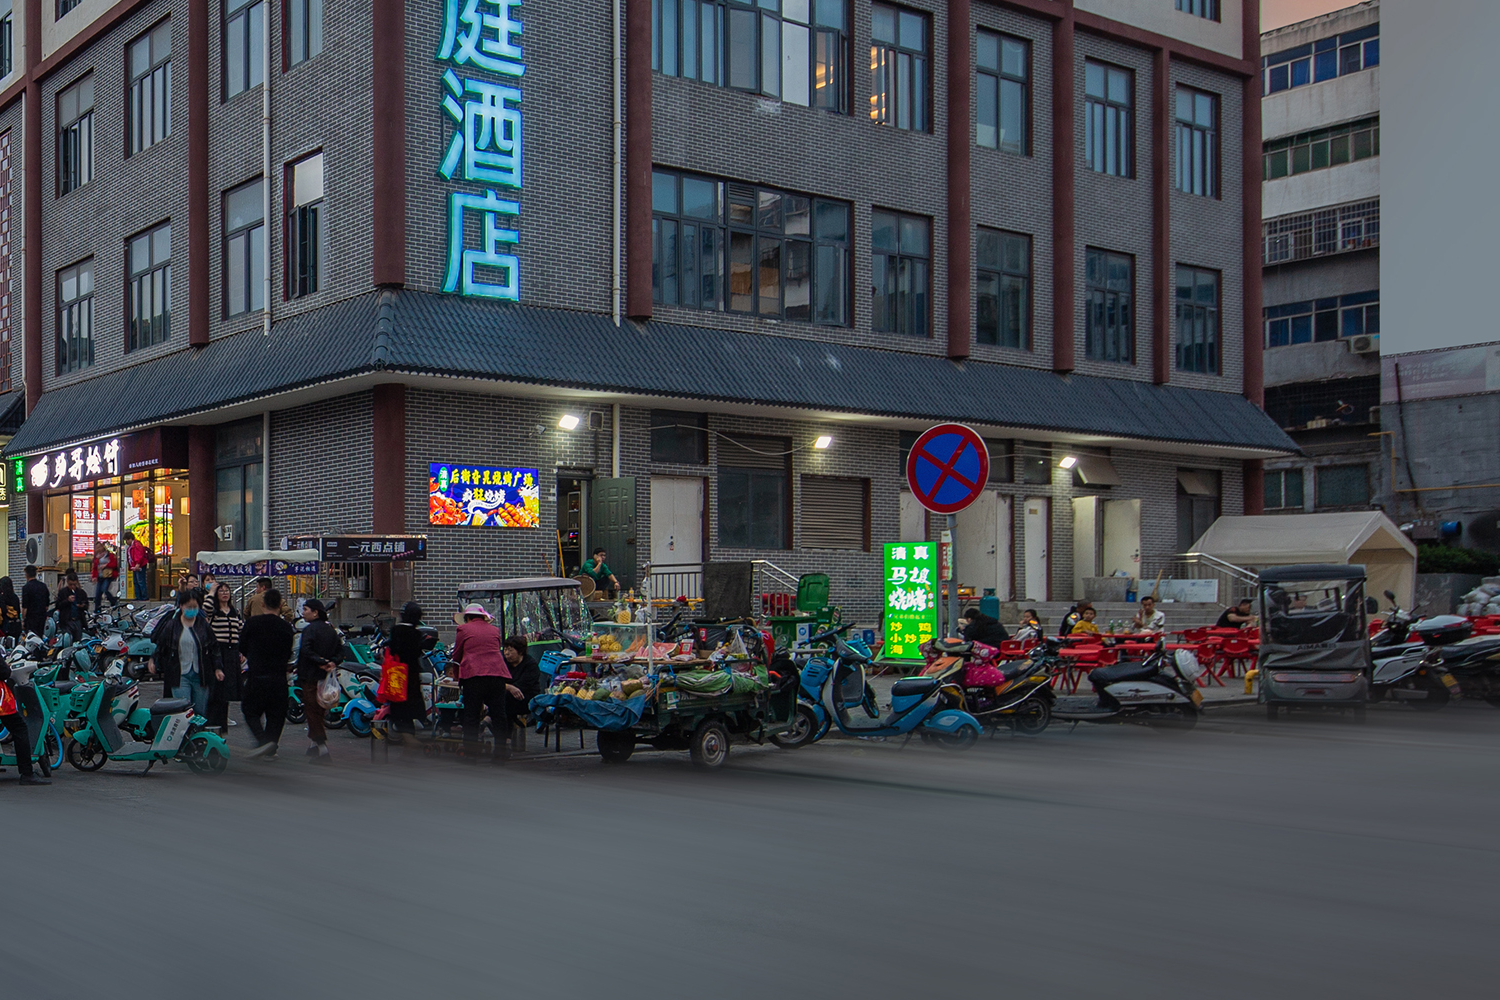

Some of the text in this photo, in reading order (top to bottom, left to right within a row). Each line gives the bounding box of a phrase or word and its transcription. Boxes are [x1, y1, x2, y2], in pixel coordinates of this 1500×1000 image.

[348, 541, 405, 553] 一元西点铺
[891, 545, 929, 560] 清真
[888, 585, 928, 612] 烧烤
